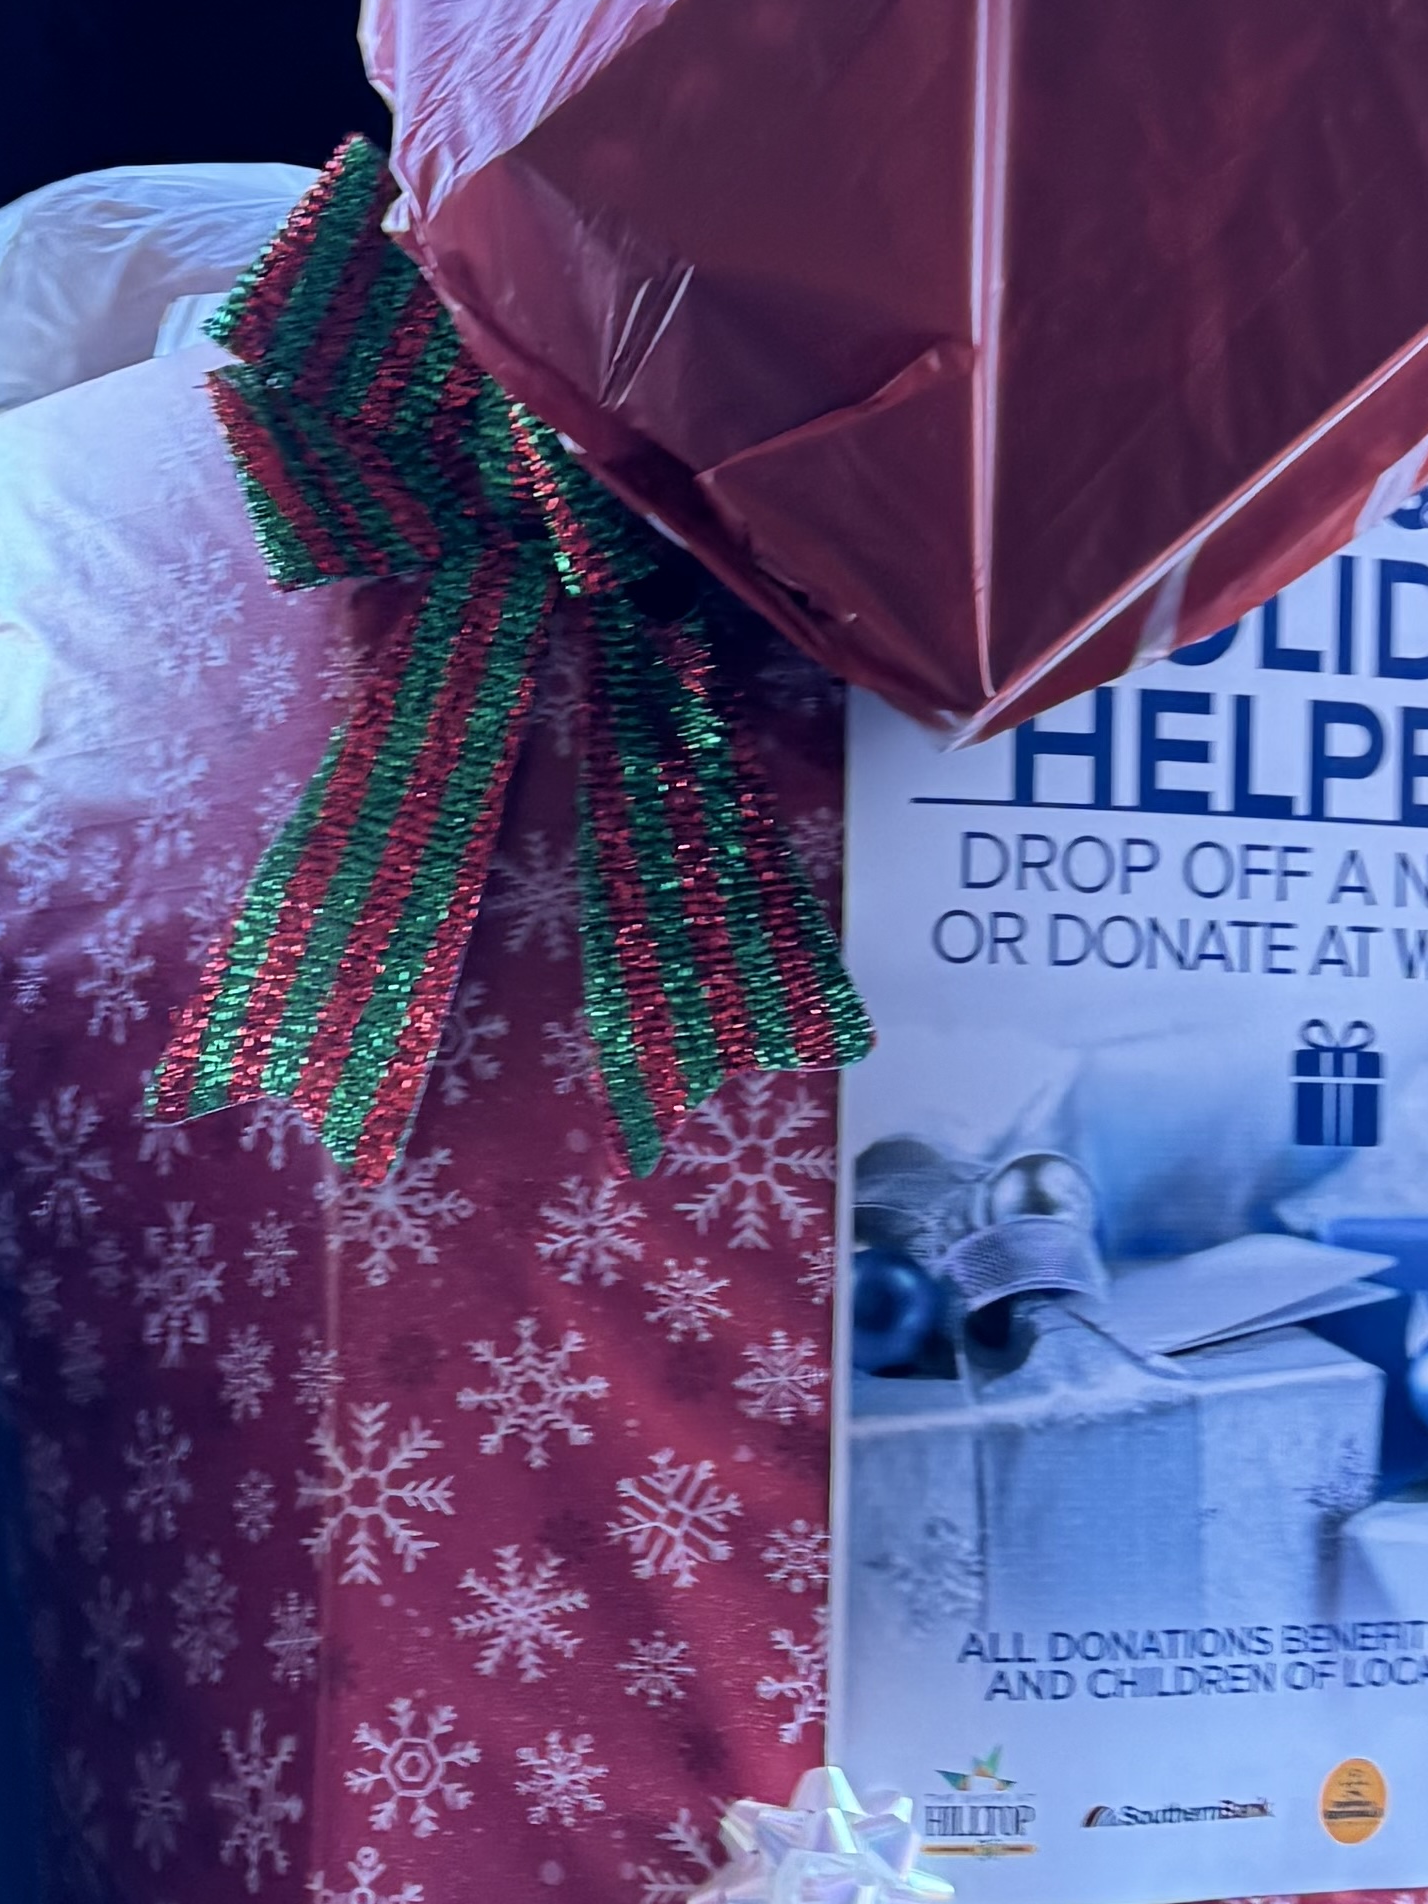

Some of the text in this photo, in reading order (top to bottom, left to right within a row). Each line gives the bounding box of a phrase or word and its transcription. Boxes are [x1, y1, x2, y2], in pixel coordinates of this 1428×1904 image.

[960, 831, 1161, 895] DROP
[1181, 840, 1315, 902] OFF
[1327, 849, 1379, 907] A
[931, 909, 1029, 965] OR
[1047, 912, 1299, 975] DONATE
[1307, 924, 1384, 979] AT
[956, 1632, 1037, 1664] ALL
[1047, 1627, 1273, 1663] DONATIONS
[983, 1669, 1078, 1702] AND
[1086, 1661, 1278, 1698] CHILDREN
[1282, 1658, 1338, 1691] OF
